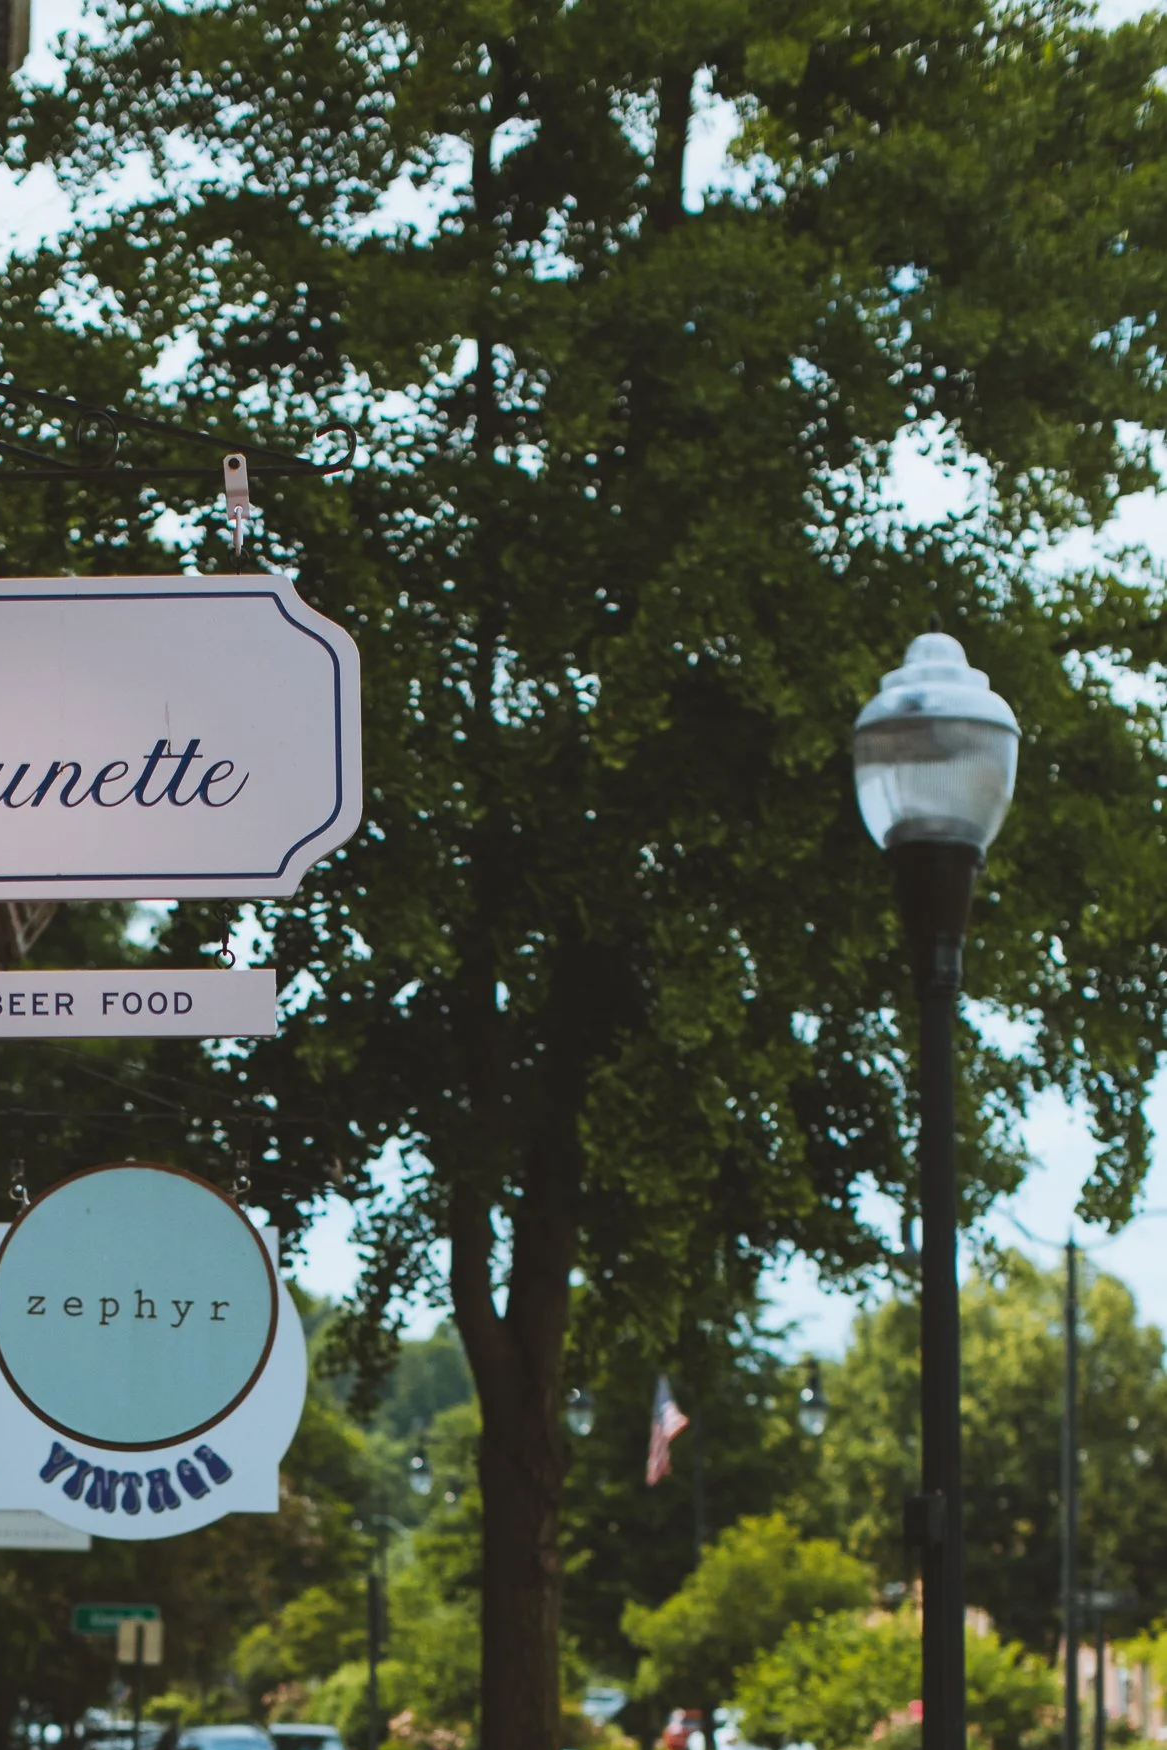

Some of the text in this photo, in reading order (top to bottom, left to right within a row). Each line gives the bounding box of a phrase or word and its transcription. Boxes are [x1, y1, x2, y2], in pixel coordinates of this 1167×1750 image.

[101, 991, 193, 1016] FOOD
[27, 1289, 230, 1328] zephyr
[39, 1441, 232, 1515] VINTAGE
